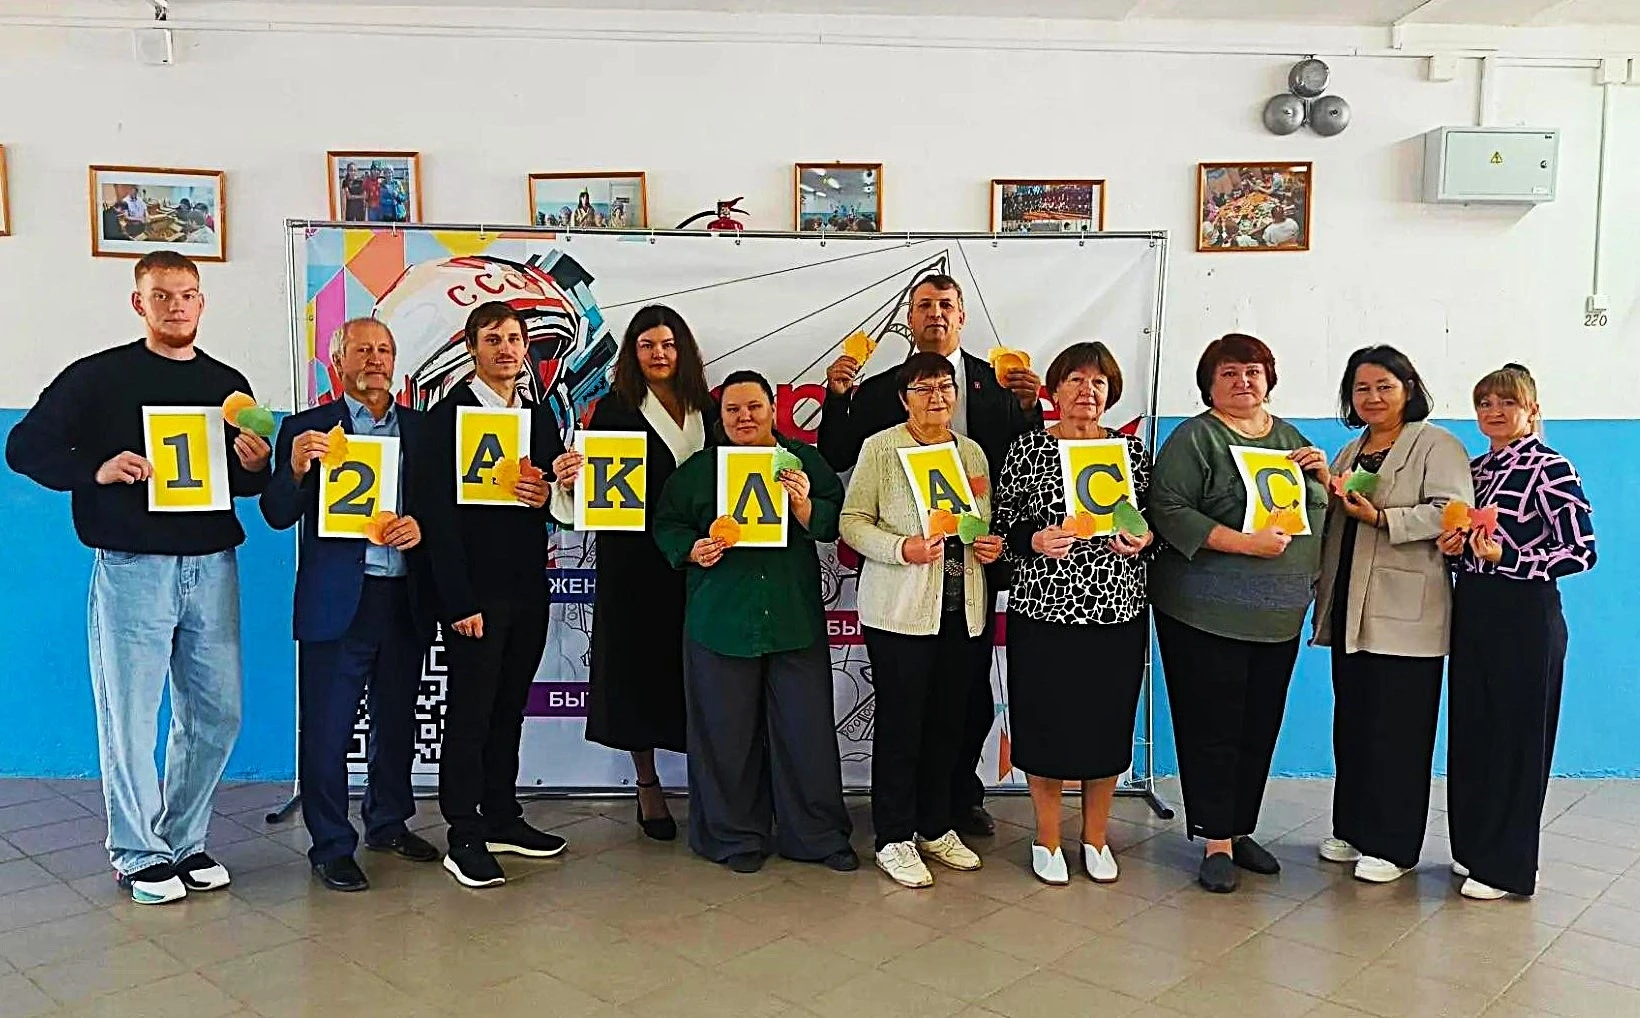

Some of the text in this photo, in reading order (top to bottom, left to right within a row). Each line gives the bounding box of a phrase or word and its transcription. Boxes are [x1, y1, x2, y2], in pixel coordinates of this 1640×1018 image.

[1584, 314, 1607, 327] 220
[162, 433, 203, 488] 1
[462, 433, 505, 485] А
[587, 457, 645, 509] К
[328, 461, 376, 517] 2
[732, 472, 782, 524] Л
[928, 469, 972, 515] А
[1076, 463, 1129, 515] С
[1255, 468, 1299, 512] С
[548, 578, 596, 594] ЖЕН
[827, 620, 861, 636] БЫ
[549, 691, 589, 707] БЫ
